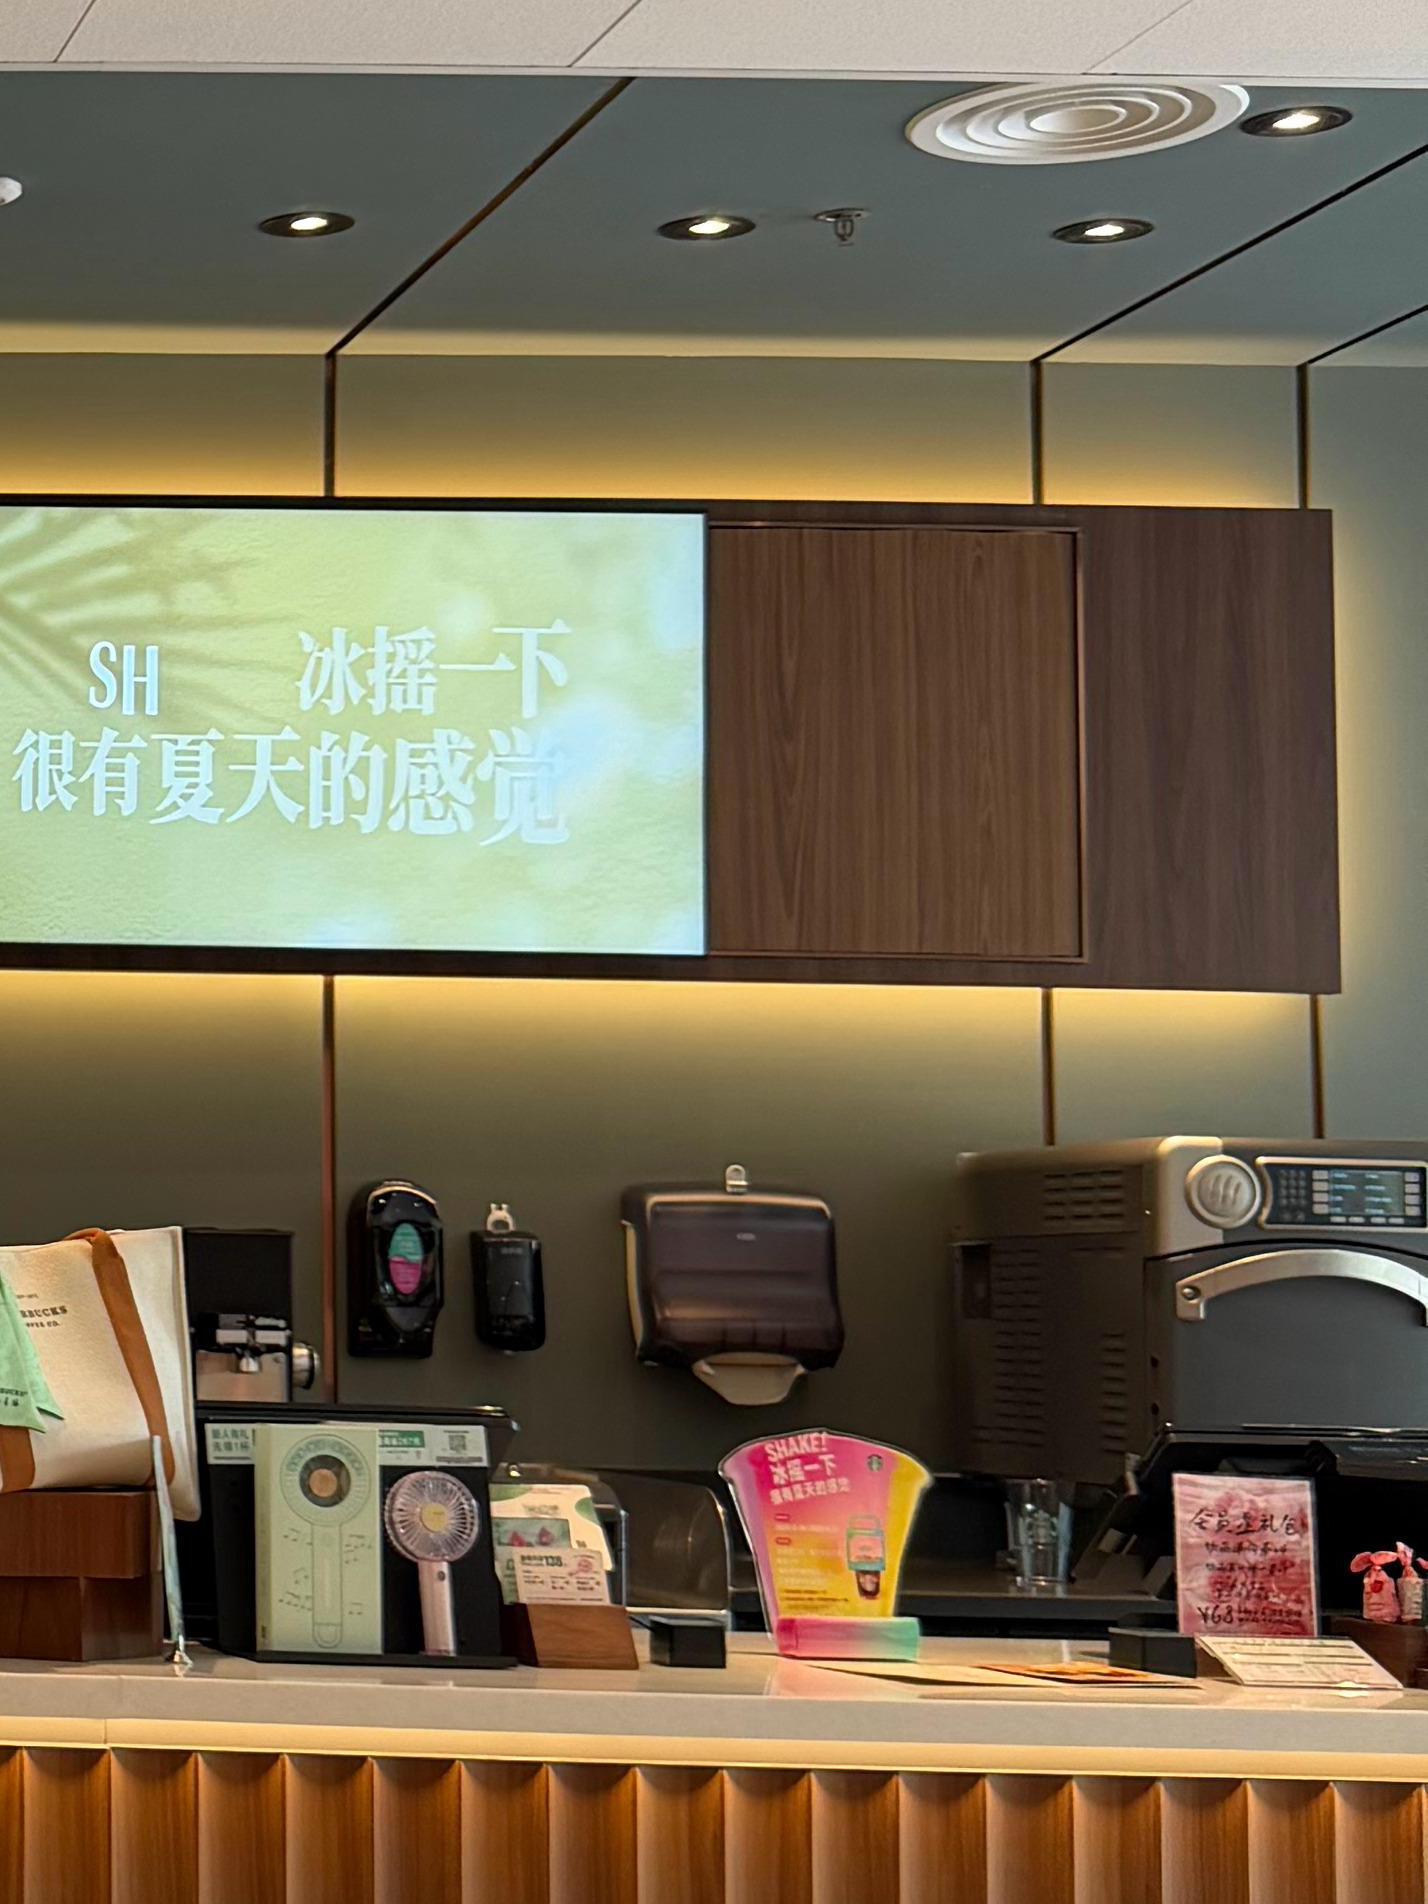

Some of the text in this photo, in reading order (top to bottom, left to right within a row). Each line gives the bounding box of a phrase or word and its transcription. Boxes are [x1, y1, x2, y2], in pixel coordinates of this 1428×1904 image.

[88, 641, 160, 717] SH
[294, 618, 572, 719] 冰摇一下
[12, 725, 571, 847] 很有夏天的感觉
[764, 1431, 828, 1463] SHAKE!
[769, 1453, 837, 1486] 冰摇一下
